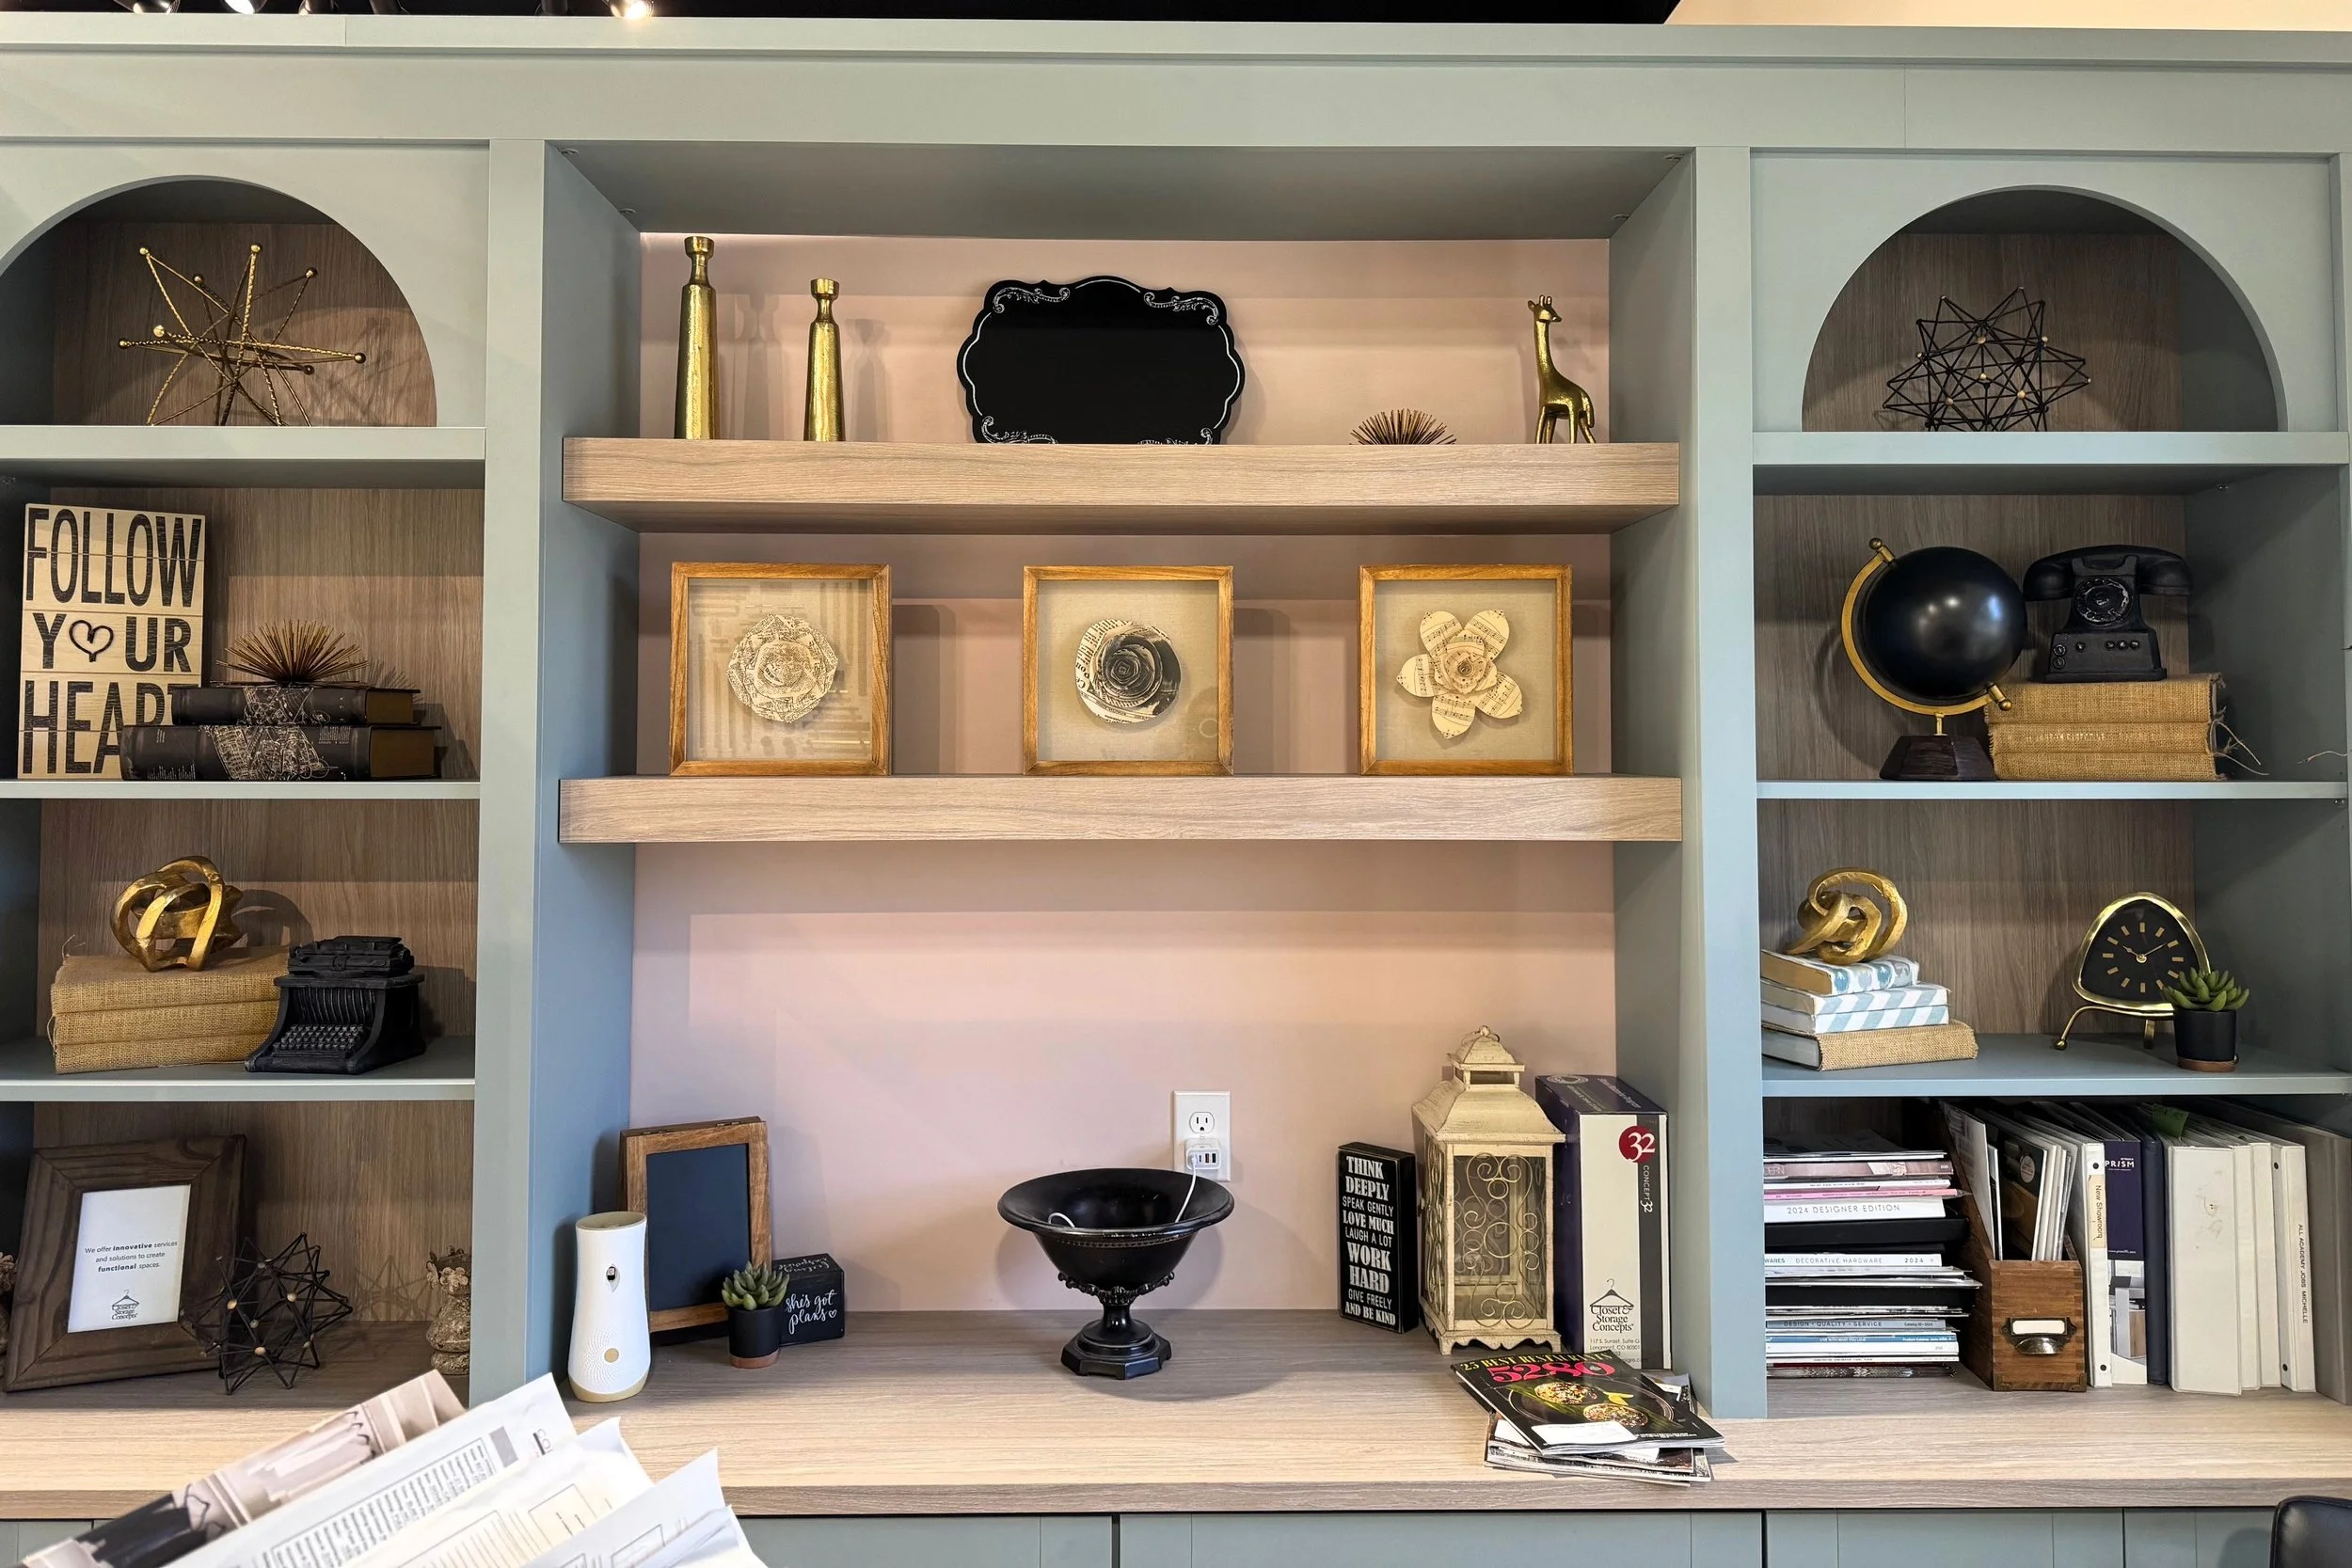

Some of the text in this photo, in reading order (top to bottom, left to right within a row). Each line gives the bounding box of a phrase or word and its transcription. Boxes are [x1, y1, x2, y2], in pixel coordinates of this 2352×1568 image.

[25, 507, 202, 608] FOLLOW
[22, 679, 199, 775] HEA
[1628, 1132, 1656, 1162] 32
[1345, 1155, 1384, 1180] THINK
[2105, 1160, 2135, 1168] PRISM
[1344, 1175, 1390, 1201] DEEPLY
[1342, 1196, 1394, 1217] SPEAK GENTLY
[1812, 1205, 1859, 1213] DESIGNER
[1862, 1204, 1900, 1212] EDITION
[1343, 1210, 1394, 1235] LOVE MUCH
[113, 1243, 152, 1252] innovative
[1344, 1226, 1392, 1248] LAUGH A LOT
[98, 1263, 136, 1272] functional
[1346, 1241, 1392, 1272] WORK
[1348, 1264, 1391, 1294] HARD
[814, 1289, 837, 1315] got
[1348, 1288, 1392, 1310] GIVE FREELY
[1590, 1305, 1621, 1316] Closet
[788, 1308, 828, 1335] plans
[1344, 1301, 1396, 1325] AND BE KIND
[1596, 1314, 1629, 1324] Storage
[1460, 1361, 1480, 1371] 25
[1480, 1355, 1518, 1368] BEST
[1518, 1351, 1613, 1364] RESTAURANTS
[1486, 1361, 1616, 1383] 5280
